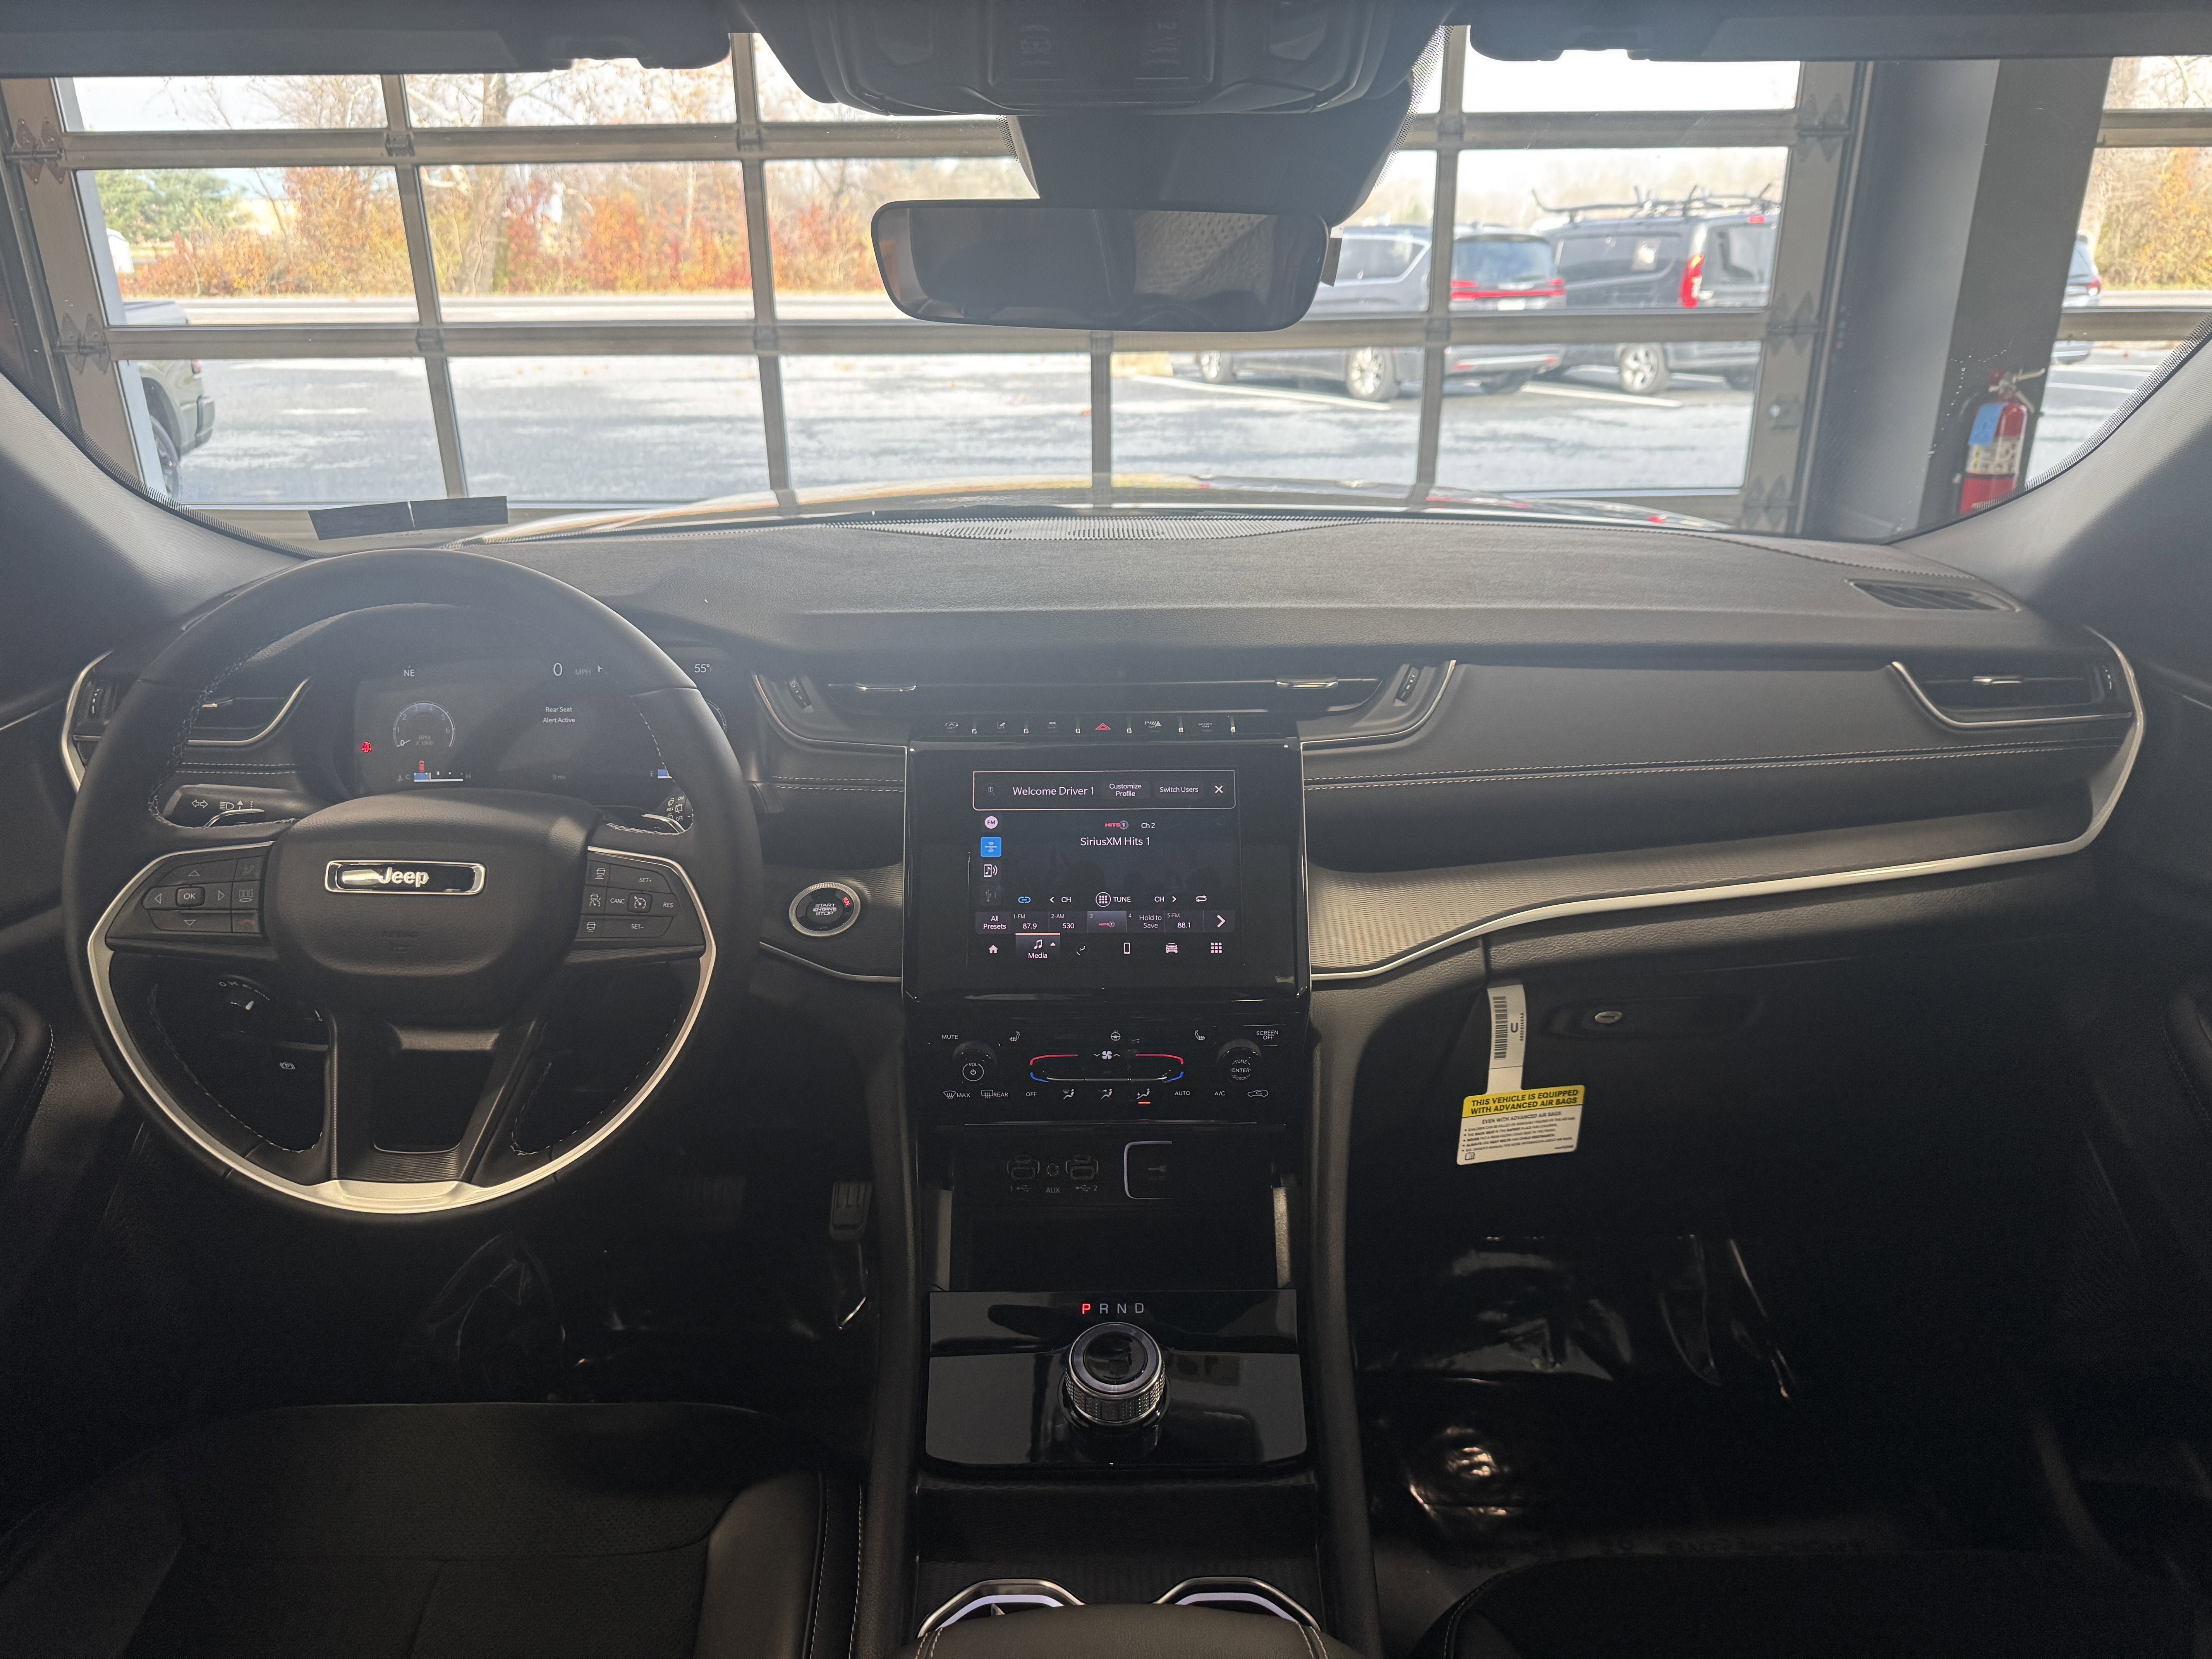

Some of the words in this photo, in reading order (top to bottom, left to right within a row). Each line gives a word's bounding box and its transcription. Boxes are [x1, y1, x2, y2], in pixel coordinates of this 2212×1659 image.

[553, 663, 563, 676] 0
[1013, 787, 1057, 795] Welcome
[1059, 787, 1088, 795] Driver
[1091, 787, 1094, 795] 1
[1080, 837, 1122, 846] SiriusXM
[1125, 836, 1144, 846] Hits
[1146, 836, 1150, 846] 1
[379, 867, 430, 888] Jeep
[1492, 1094, 1527, 1104] VEHICLE
[1538, 1089, 1578, 1099] EQUIPPED
[1471, 1106, 1491, 1115] WITH
[1493, 1101, 1538, 1111] ADVANCED
[1082, 1303, 1091, 1315] P
[1099, 1303, 1108, 1314] R
[1117, 1303, 1127, 1314] N
[1135, 1303, 1144, 1314] D
